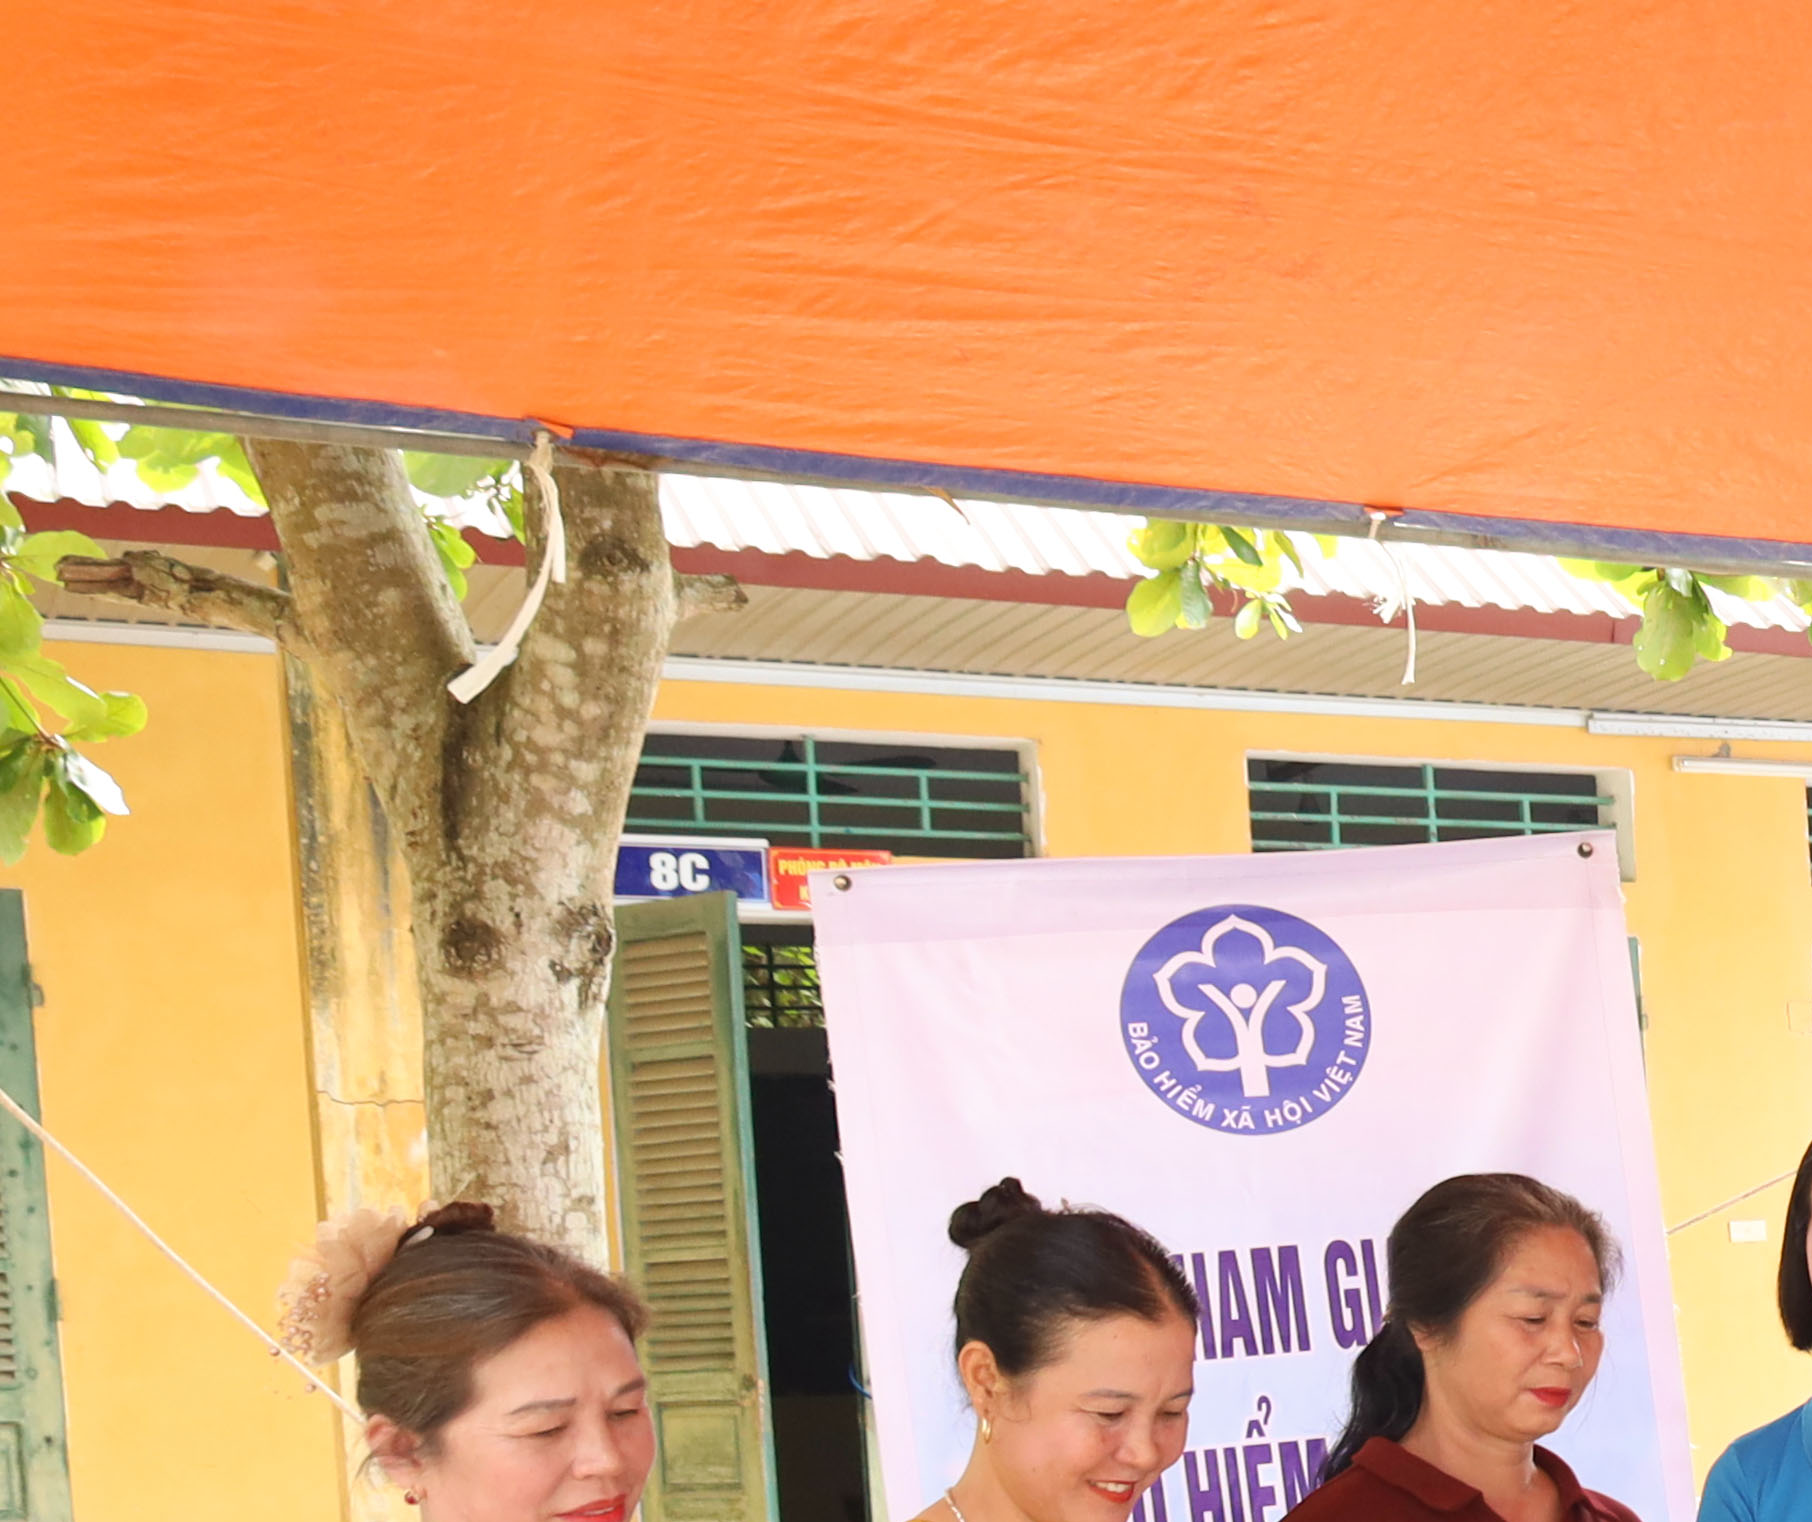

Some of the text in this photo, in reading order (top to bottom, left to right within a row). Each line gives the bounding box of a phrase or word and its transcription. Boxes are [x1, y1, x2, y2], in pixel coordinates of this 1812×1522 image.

[650, 851, 711, 893] 8C
[1127, 994, 1364, 1130] BẢO HIỂM XÃ HỘI VIỆT NAM
[1168, 1245, 1311, 1361] HAM
